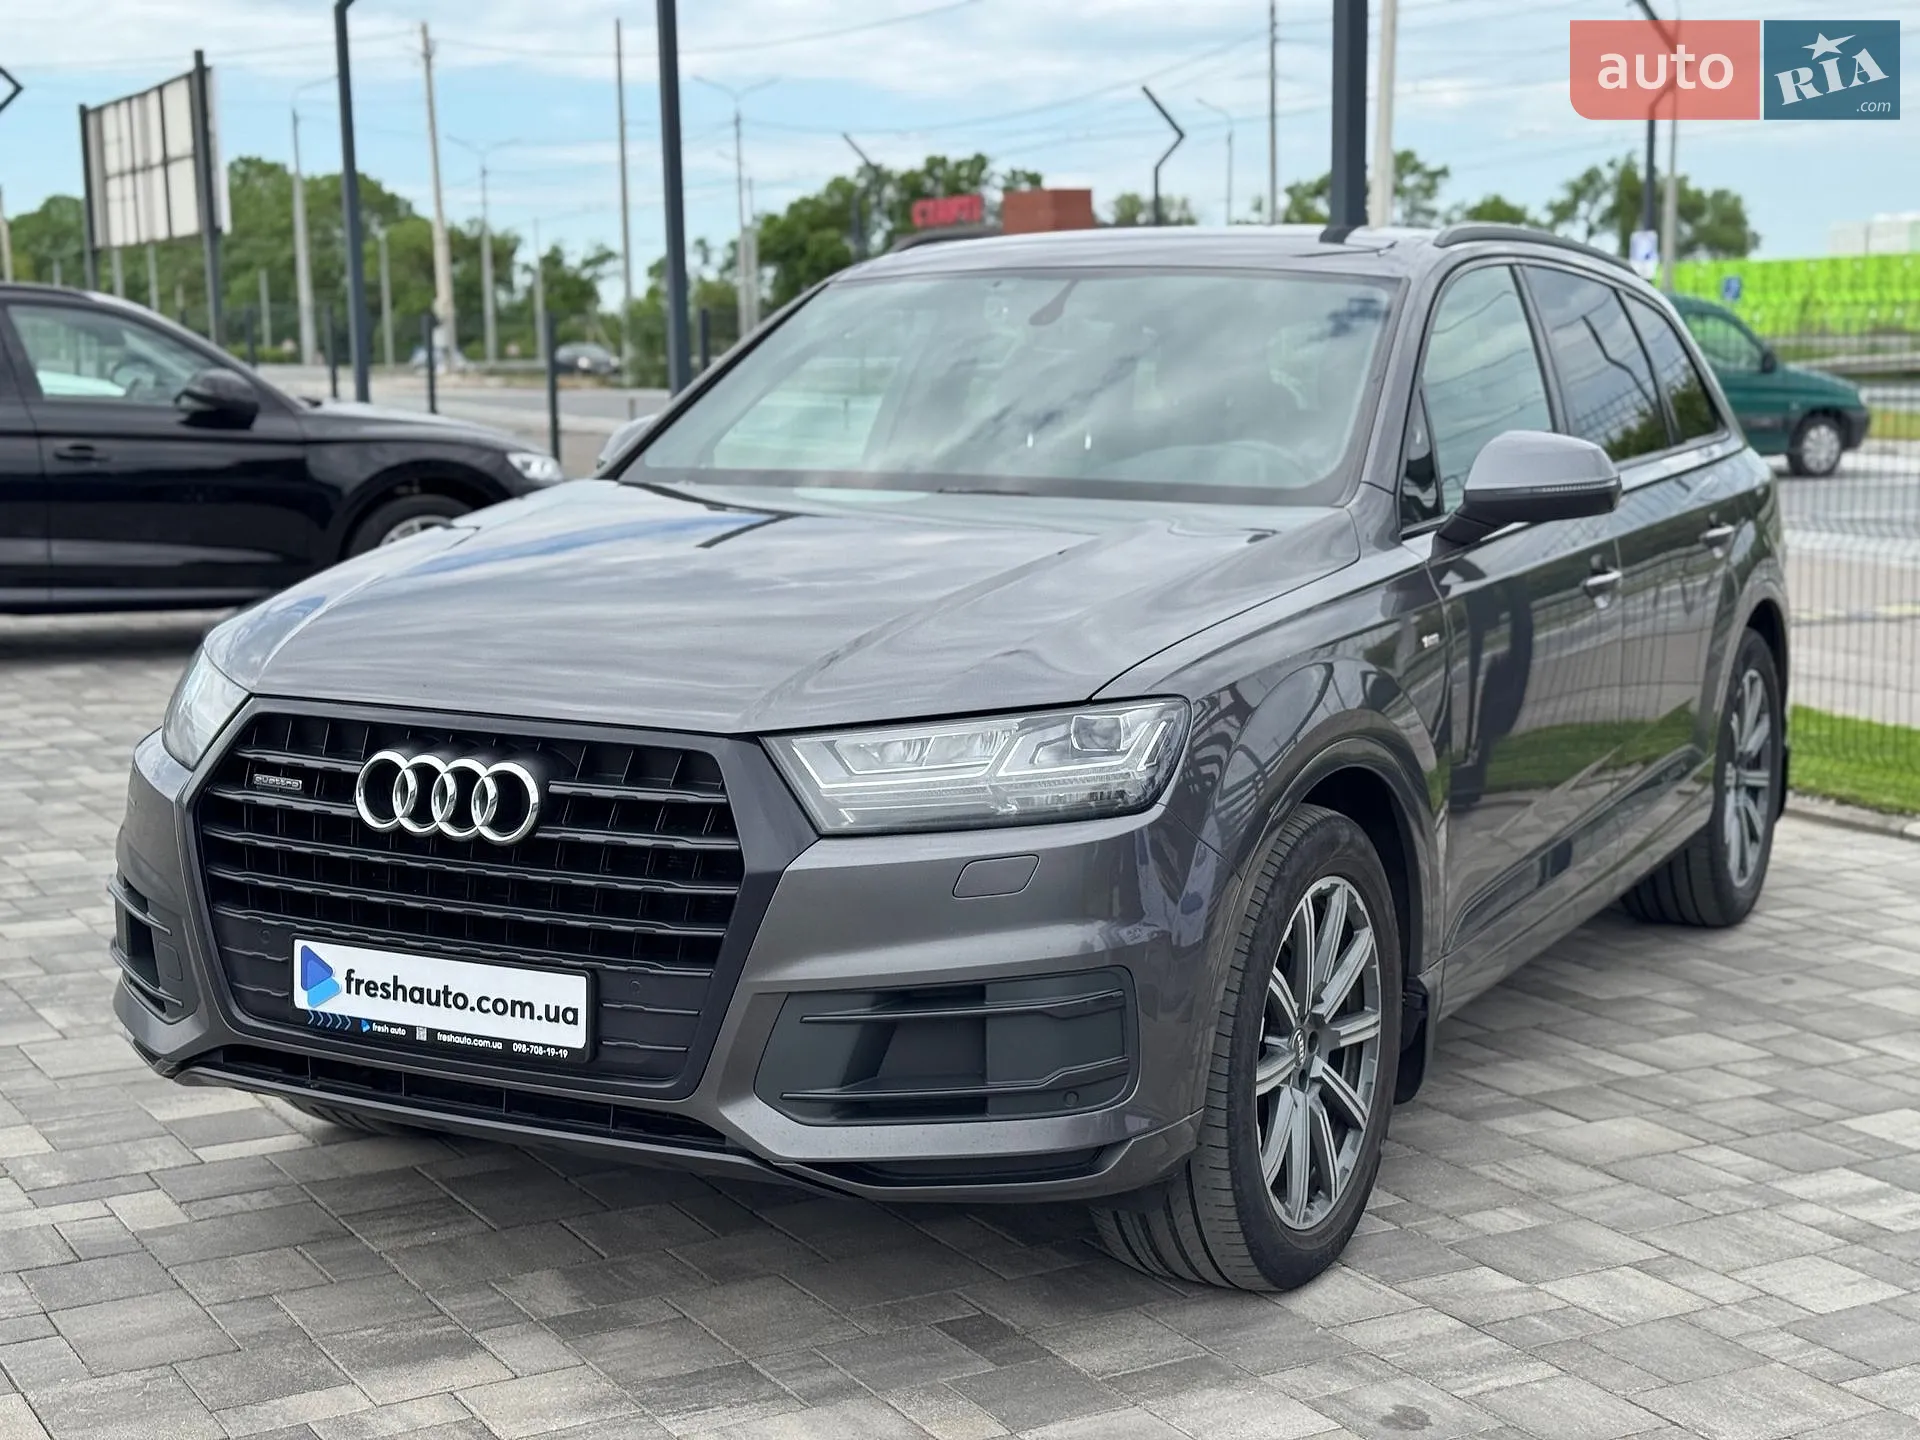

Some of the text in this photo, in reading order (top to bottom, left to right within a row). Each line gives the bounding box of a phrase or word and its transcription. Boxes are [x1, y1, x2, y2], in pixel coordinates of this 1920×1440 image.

[345, 968, 580, 1026] freshauto.com.ua
[372, 1022, 407, 1036] fresh auto
[437, 1032, 503, 1050] freshauto.com.ua
[512, 1042, 569, 1059] 098-708-19-19
